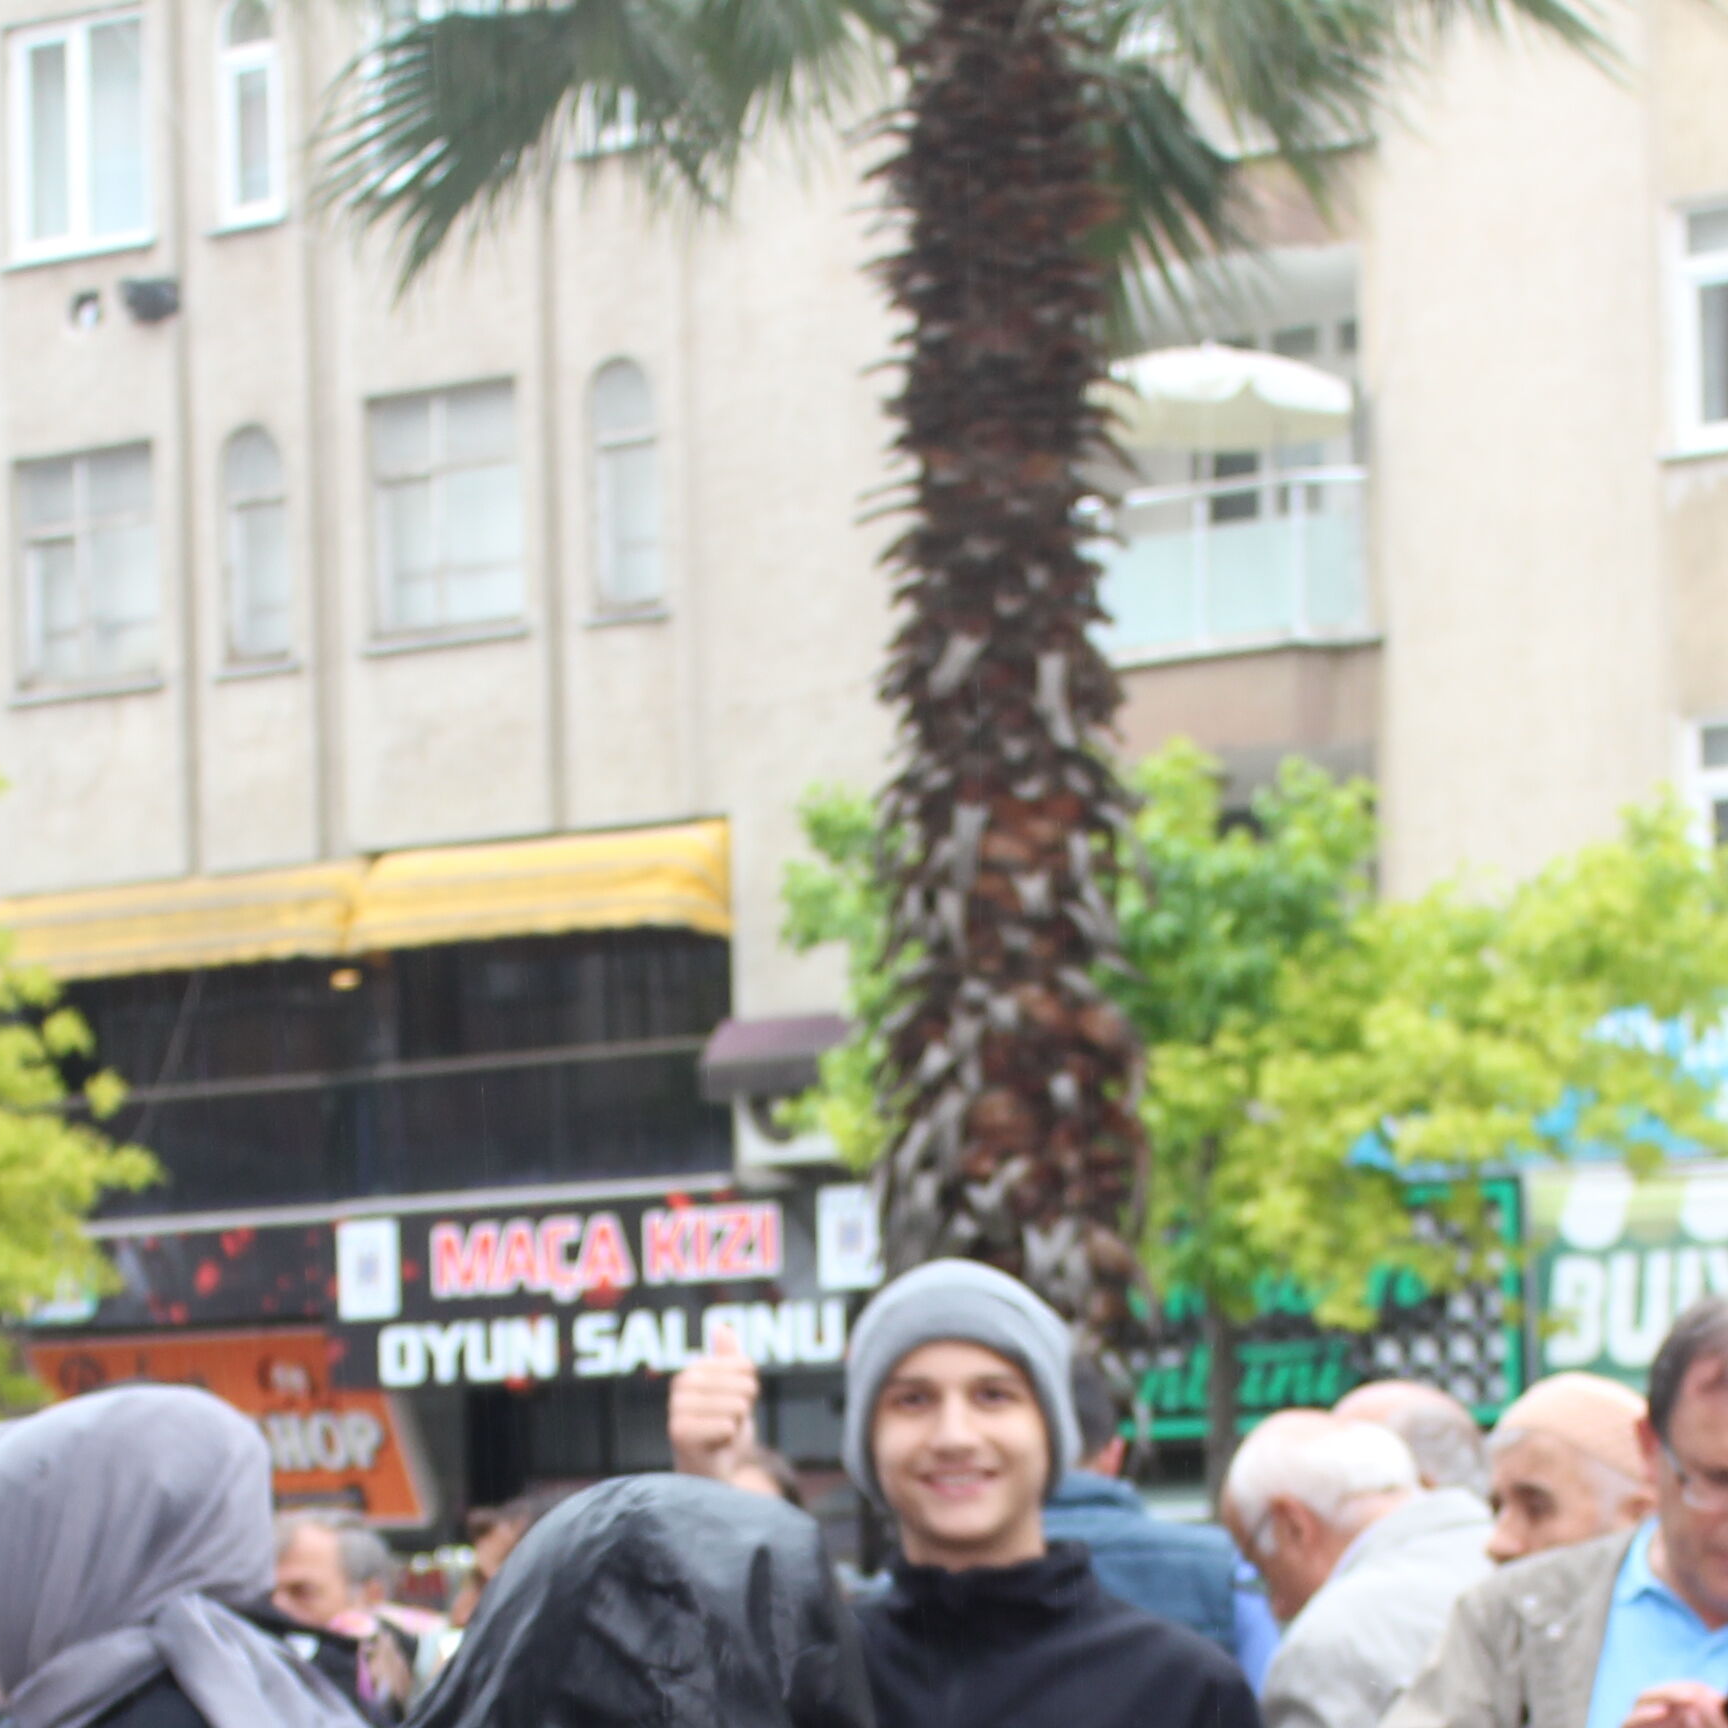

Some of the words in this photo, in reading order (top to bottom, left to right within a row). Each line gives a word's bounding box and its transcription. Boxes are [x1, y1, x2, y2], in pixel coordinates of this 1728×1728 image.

[429, 1210, 638, 1304] MAÇA
[641, 1199, 784, 1286] KIZI
[377, 1314, 559, 1389] OYUN
[262, 1408, 385, 1473] HOP
